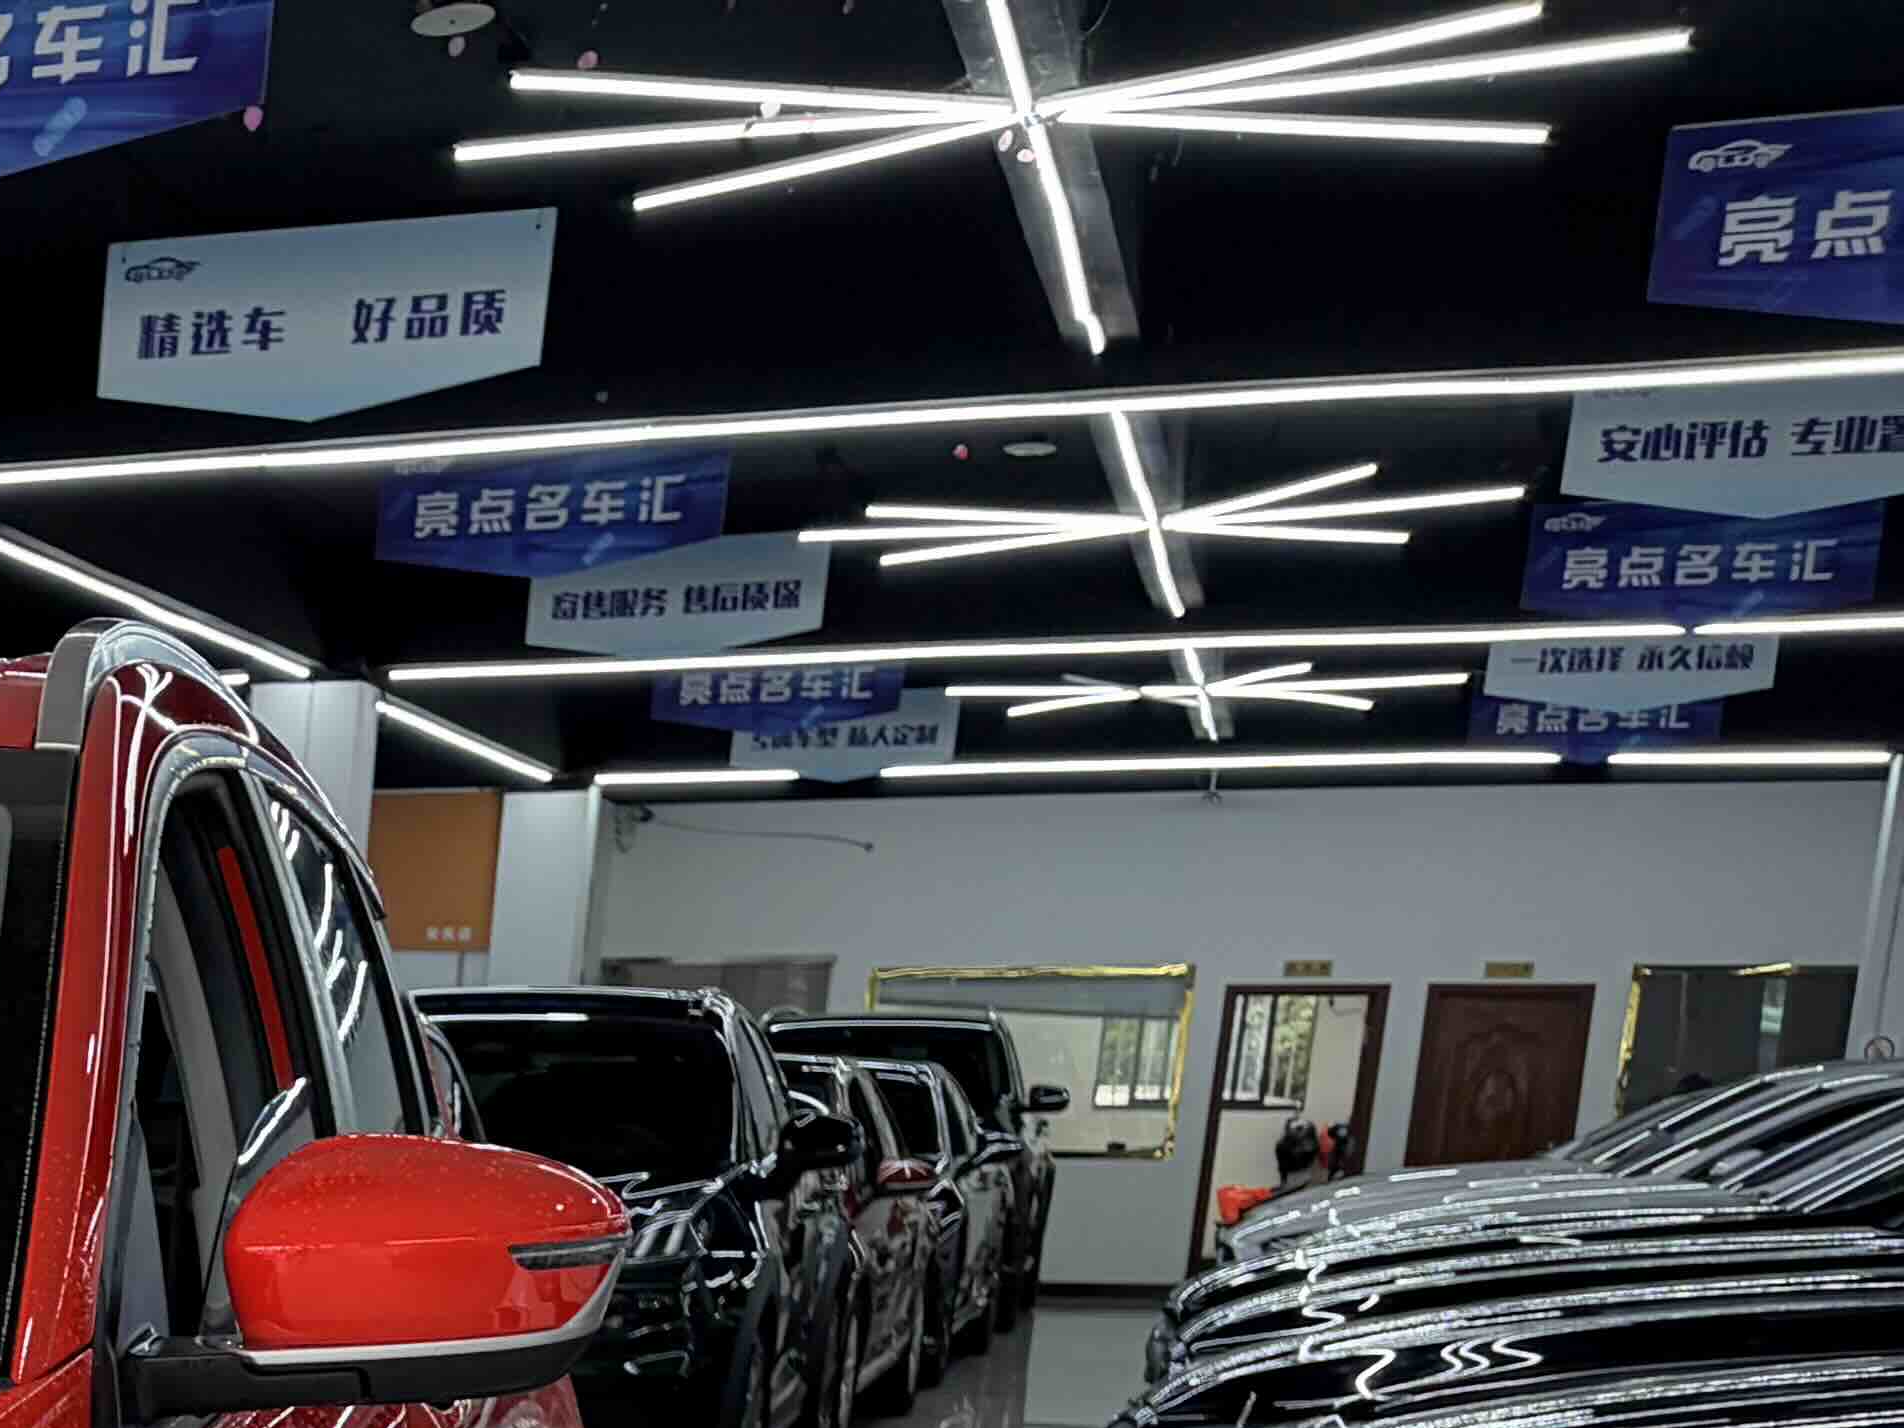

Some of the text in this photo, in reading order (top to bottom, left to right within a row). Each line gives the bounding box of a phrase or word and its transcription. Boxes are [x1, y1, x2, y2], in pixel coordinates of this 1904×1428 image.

[1717, 190, 1893, 266] 亮点
[136, 288, 507, 360] 精选车 好品质
[1597, 419, 1770, 463] 安心评估
[413, 473, 687, 539] 亮点名车汇
[1561, 538, 1839, 590] 亮点名车汇
